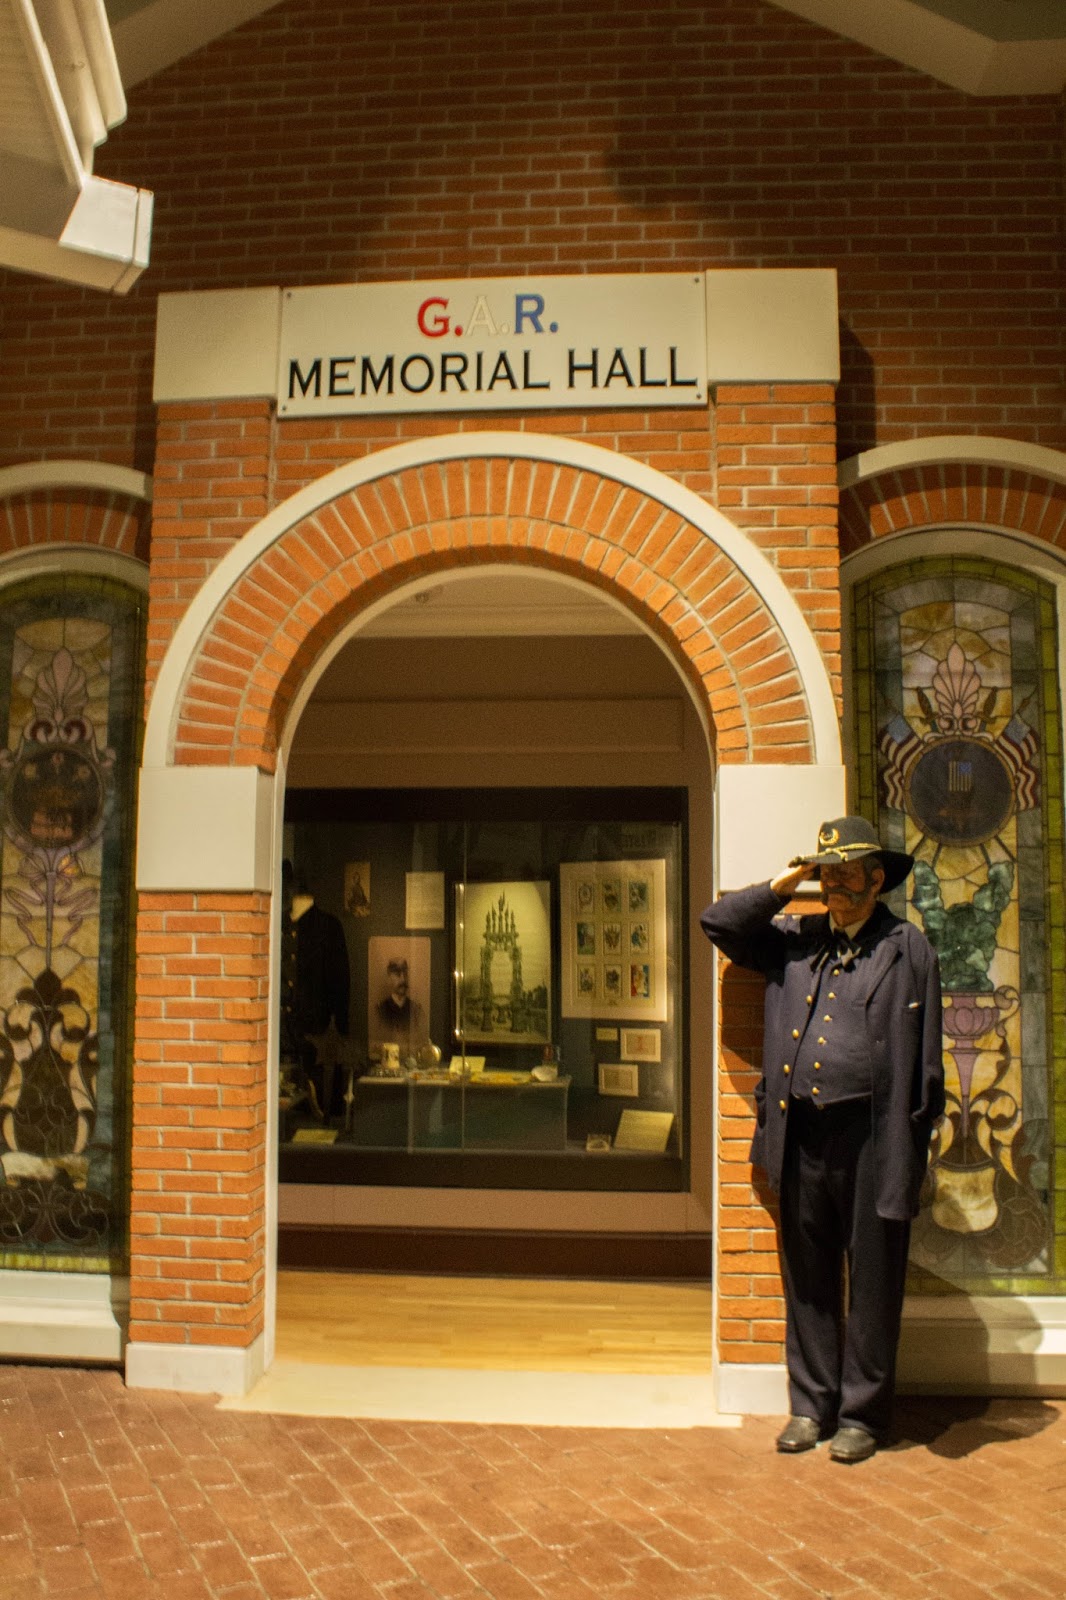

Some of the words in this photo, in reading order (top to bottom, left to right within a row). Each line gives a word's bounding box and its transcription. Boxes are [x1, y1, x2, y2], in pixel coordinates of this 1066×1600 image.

[416, 293, 559, 338] G.A.R.
[287, 349, 551, 400] MEMORIAL
[566, 346, 699, 390] HALL
